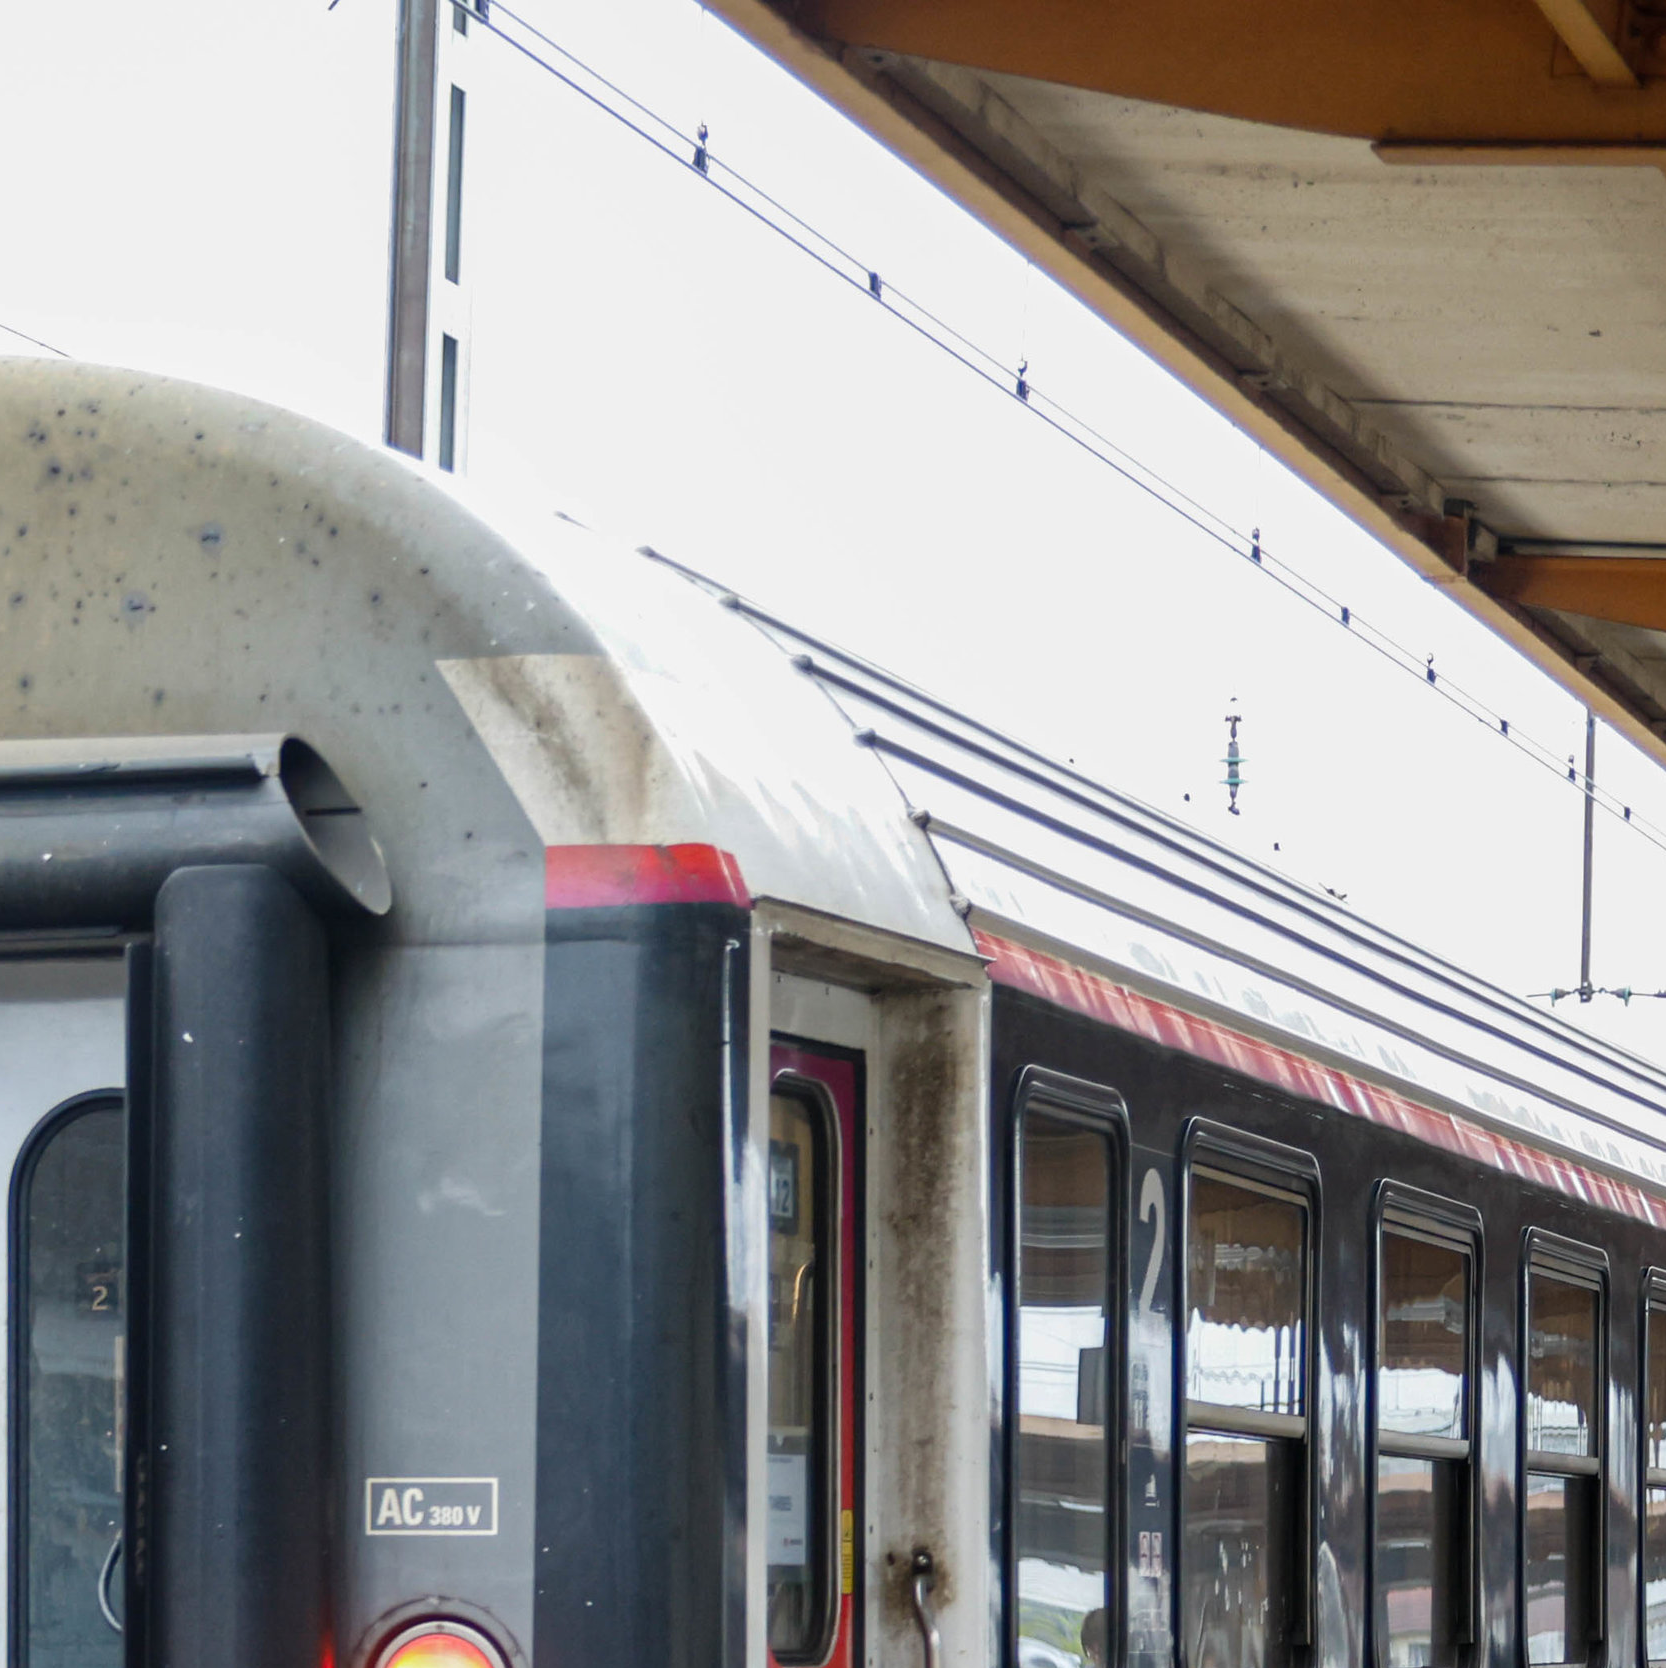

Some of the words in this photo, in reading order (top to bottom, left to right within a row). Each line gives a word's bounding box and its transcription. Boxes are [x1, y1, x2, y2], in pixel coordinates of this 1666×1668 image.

[1140, 1168, 1165, 1332] 2
[91, 1286, 109, 1311] 2
[377, 1488, 424, 1526] AC
[429, 1506, 464, 1526] 380
[466, 1505, 481, 1526] V
